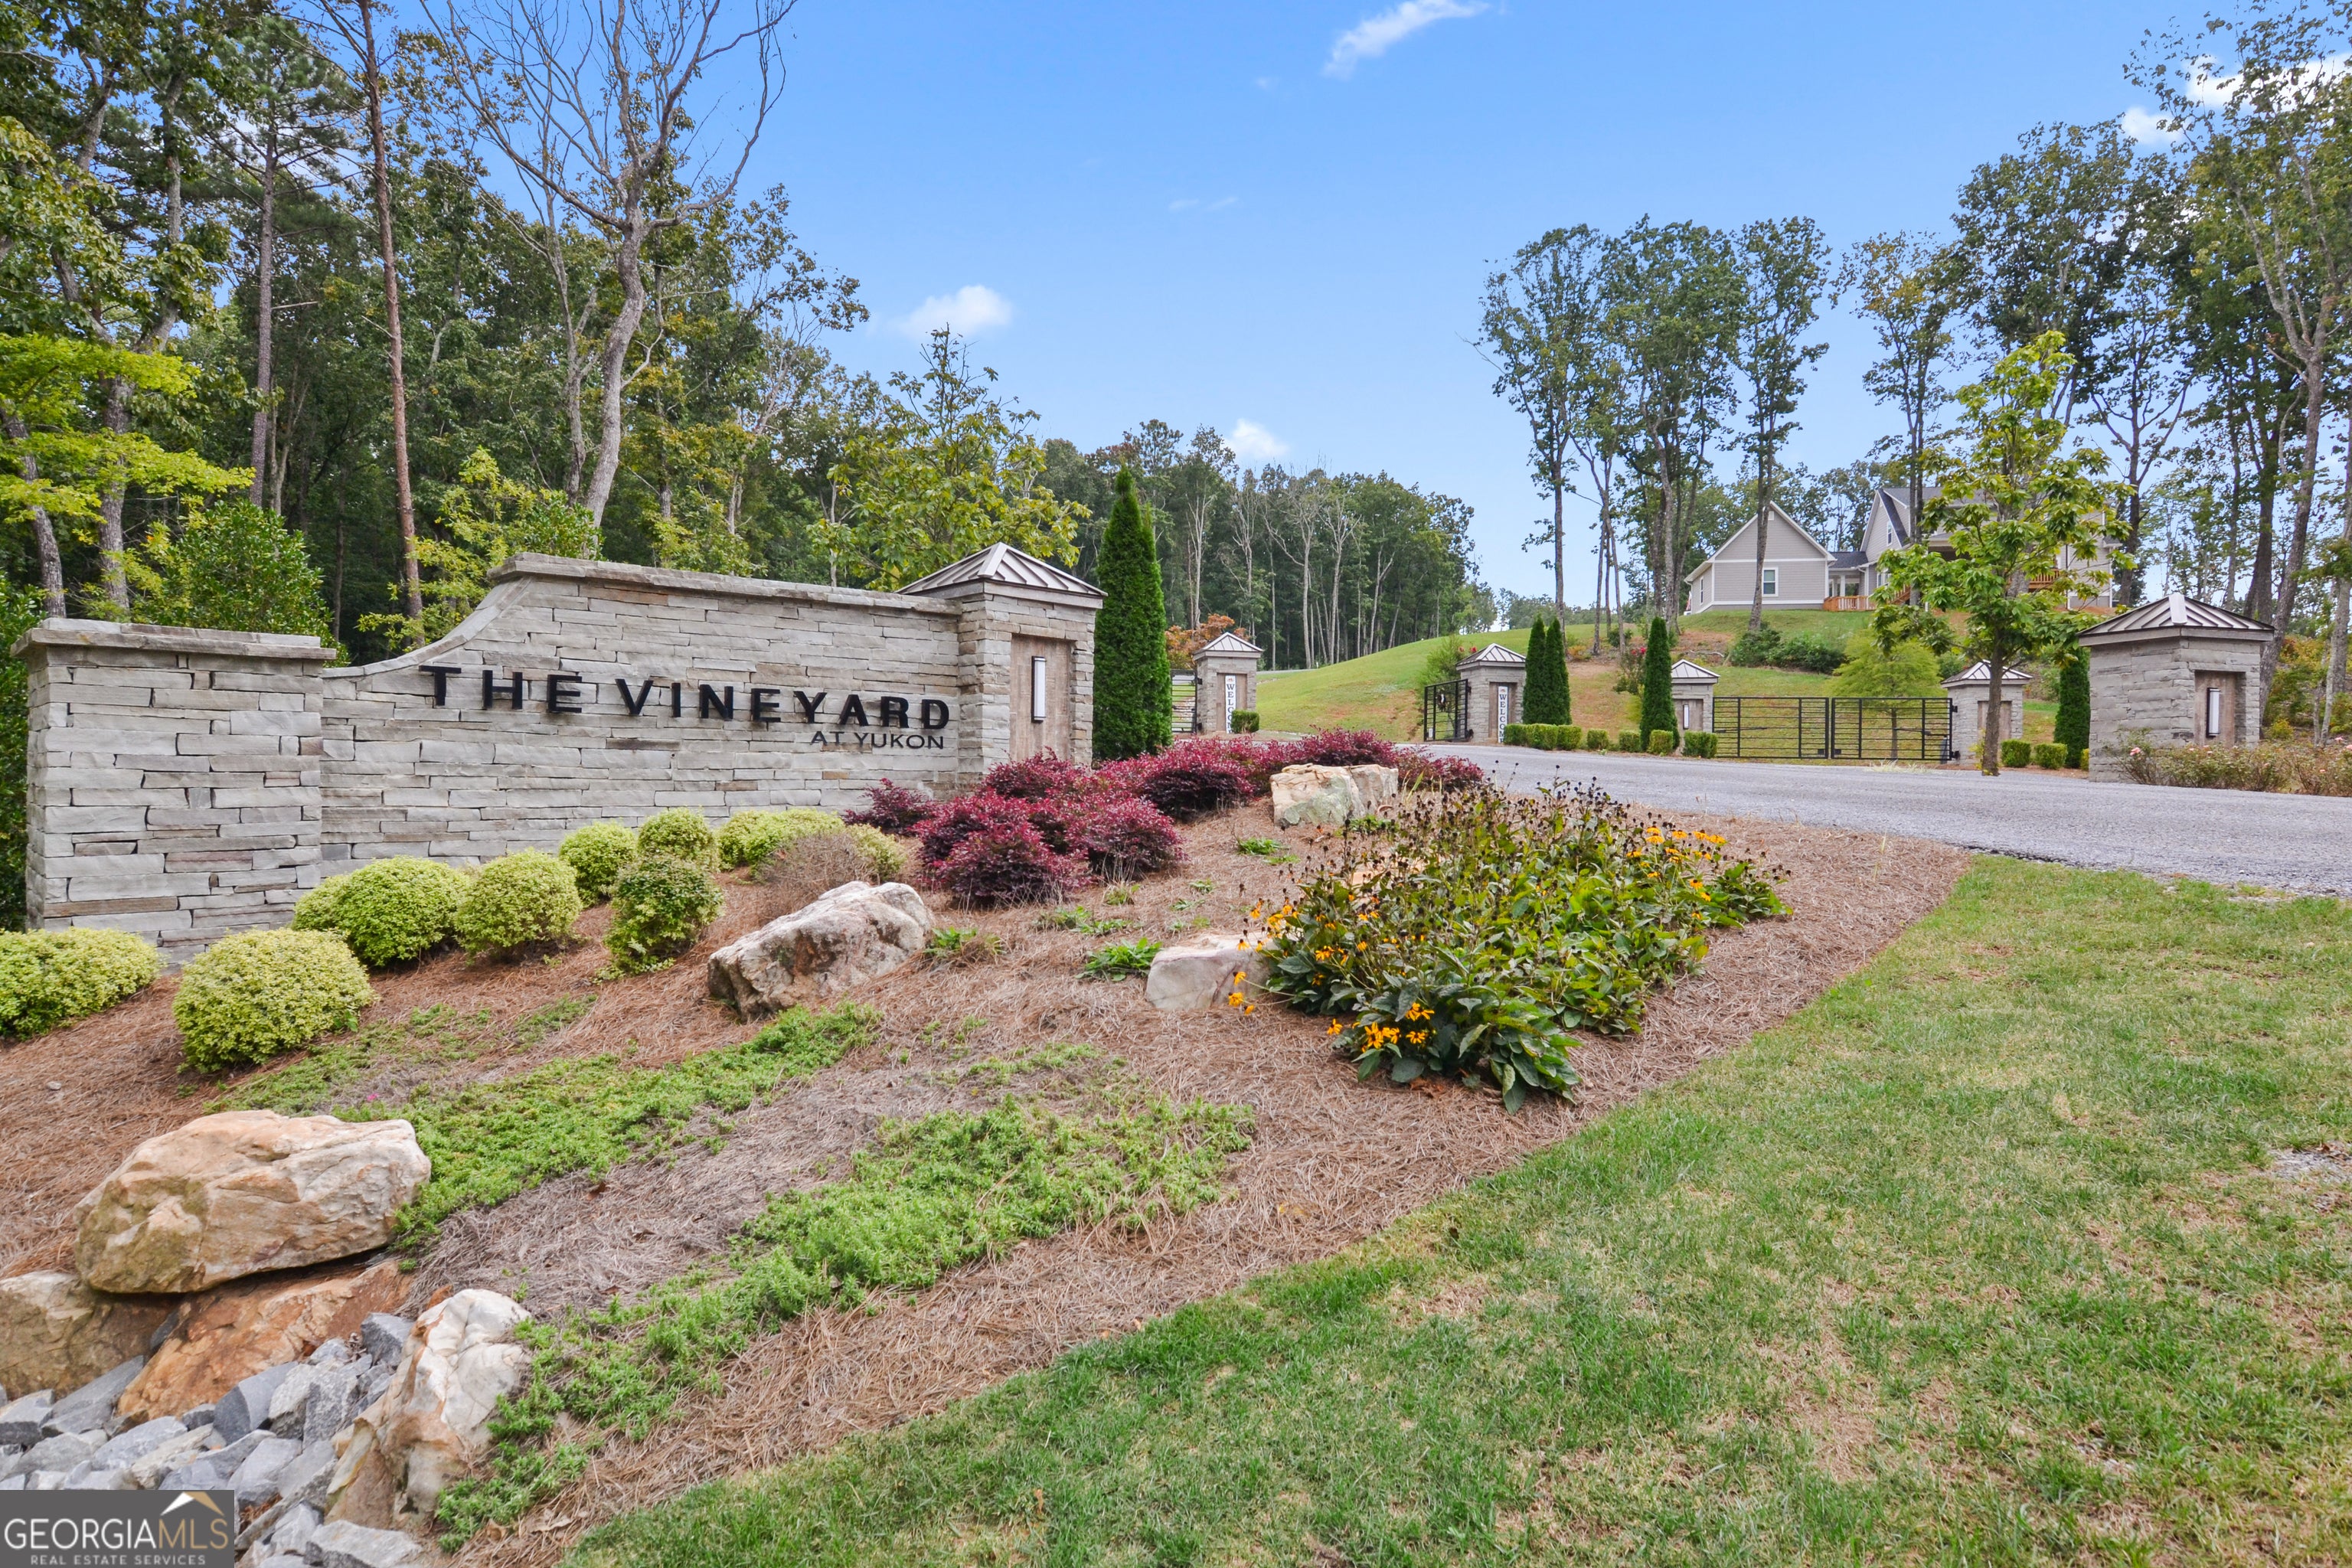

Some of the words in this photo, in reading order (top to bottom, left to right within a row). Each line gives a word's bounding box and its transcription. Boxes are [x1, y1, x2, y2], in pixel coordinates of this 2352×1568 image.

[419, 665, 582, 714] THE
[615, 678, 949, 729] VINEYARD
[811, 730, 845, 746] AT
[854, 732, 944, 750] YUKON
